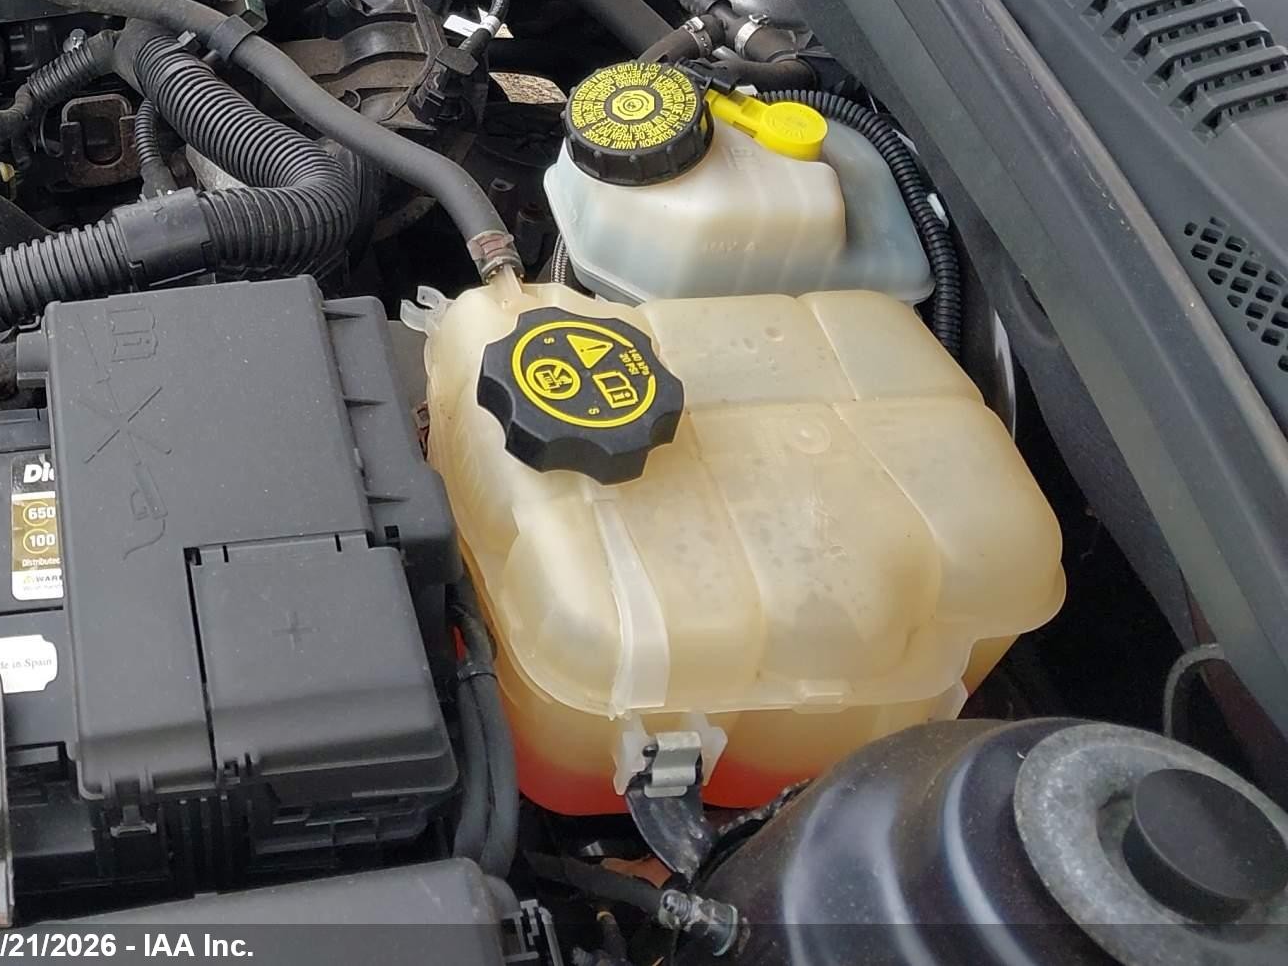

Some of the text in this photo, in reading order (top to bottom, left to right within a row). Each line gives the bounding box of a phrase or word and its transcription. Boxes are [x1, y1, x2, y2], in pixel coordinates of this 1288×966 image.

[595, 67, 616, 80] FROM
[616, 63, 637, 72] FLUID
[645, 63, 660, 72] DOT
[611, 69, 641, 82] BEFORE
[639, 128, 675, 147] BOUCHON
[611, 140, 636, 149] AVANT
[28, 506, 56, 520] 650
[29, 534, 56, 547] 100
[24, 658, 52, 670] Spain
